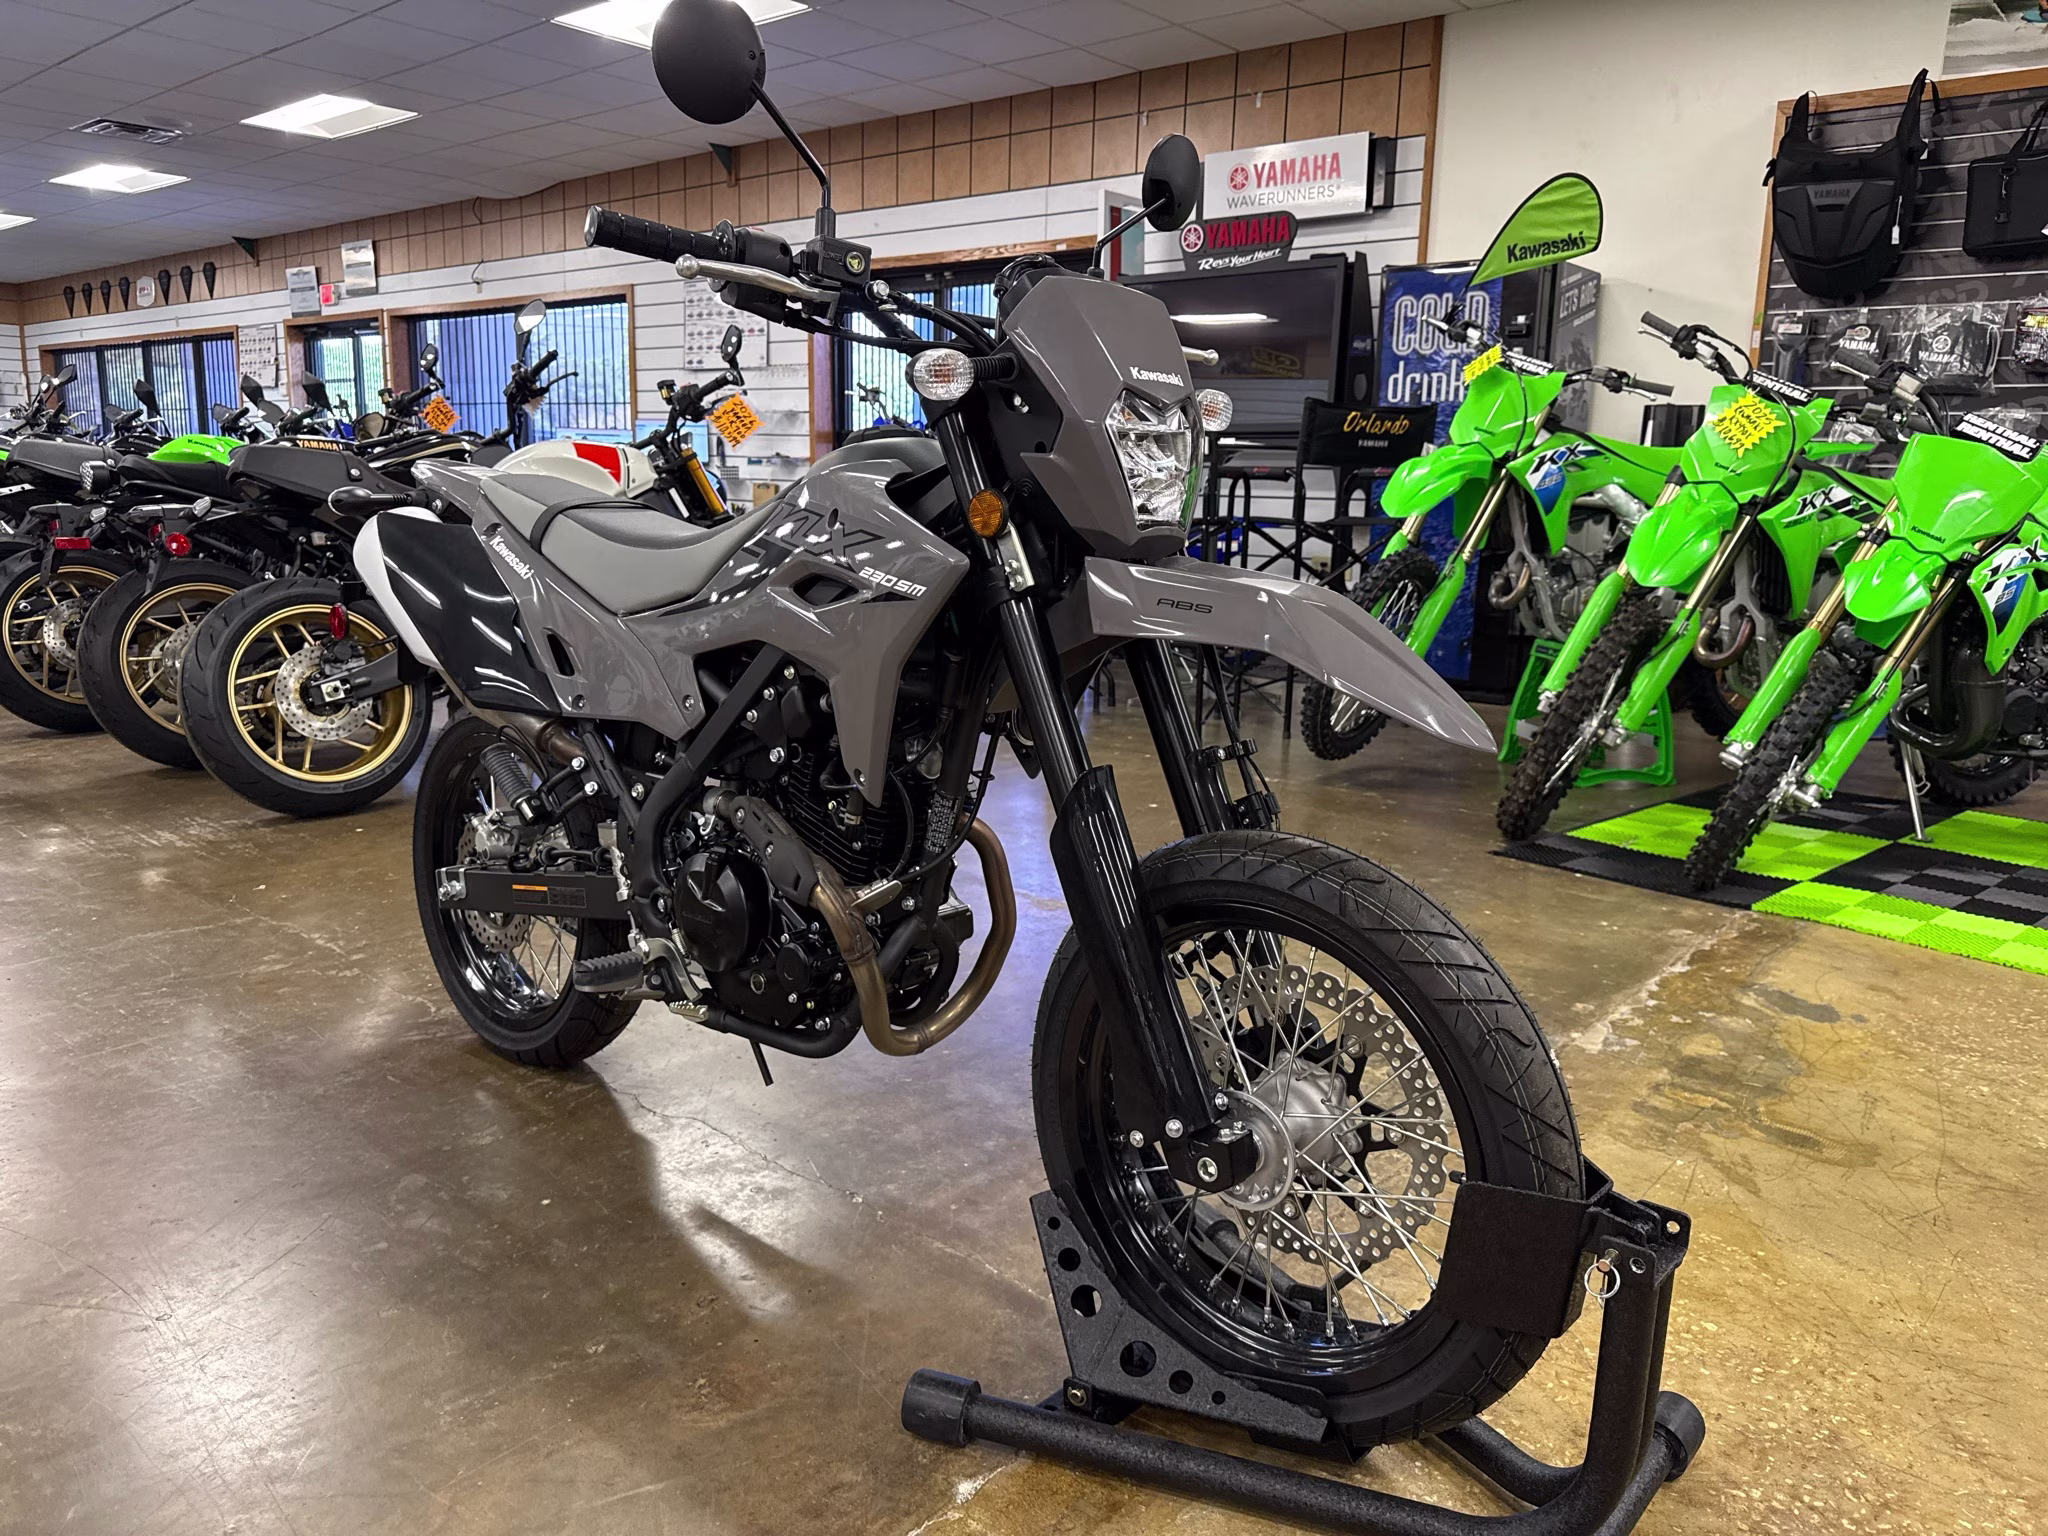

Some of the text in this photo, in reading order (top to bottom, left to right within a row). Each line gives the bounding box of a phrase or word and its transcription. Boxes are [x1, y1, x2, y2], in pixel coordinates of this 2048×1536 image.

[1253, 152, 1341, 189] YAMAHA
[1227, 184, 1336, 210] WAVERUNNERS
[1813, 188, 1850, 199] YAMAHA
[1205, 216, 1291, 249] YAMAHA
[1197, 247, 1282, 271] Revs Your Heart
[1506, 231, 1587, 264] Kawasaki
[1392, 290, 1490, 356] COLD
[1839, 338, 1878, 354] YAMAHA
[1129, 366, 1184, 387] Kawasaki
[1343, 410, 1410, 435] Orlando
[1744, 401, 1772, 425] 2025
[1358, 439, 1389, 448] YAMAHA
[1954, 421, 2033, 460] RENTHAL
[1963, 412, 2040, 449] RENTHAL
[296, 439, 340, 451] YAMAHA
[1529, 442, 1582, 476] KX
[1797, 485, 1837, 516] KX
[489, 535, 534, 580] Kawasaki
[858, 566, 928, 598] 230SM
[1156, 597, 1214, 614] ABS
